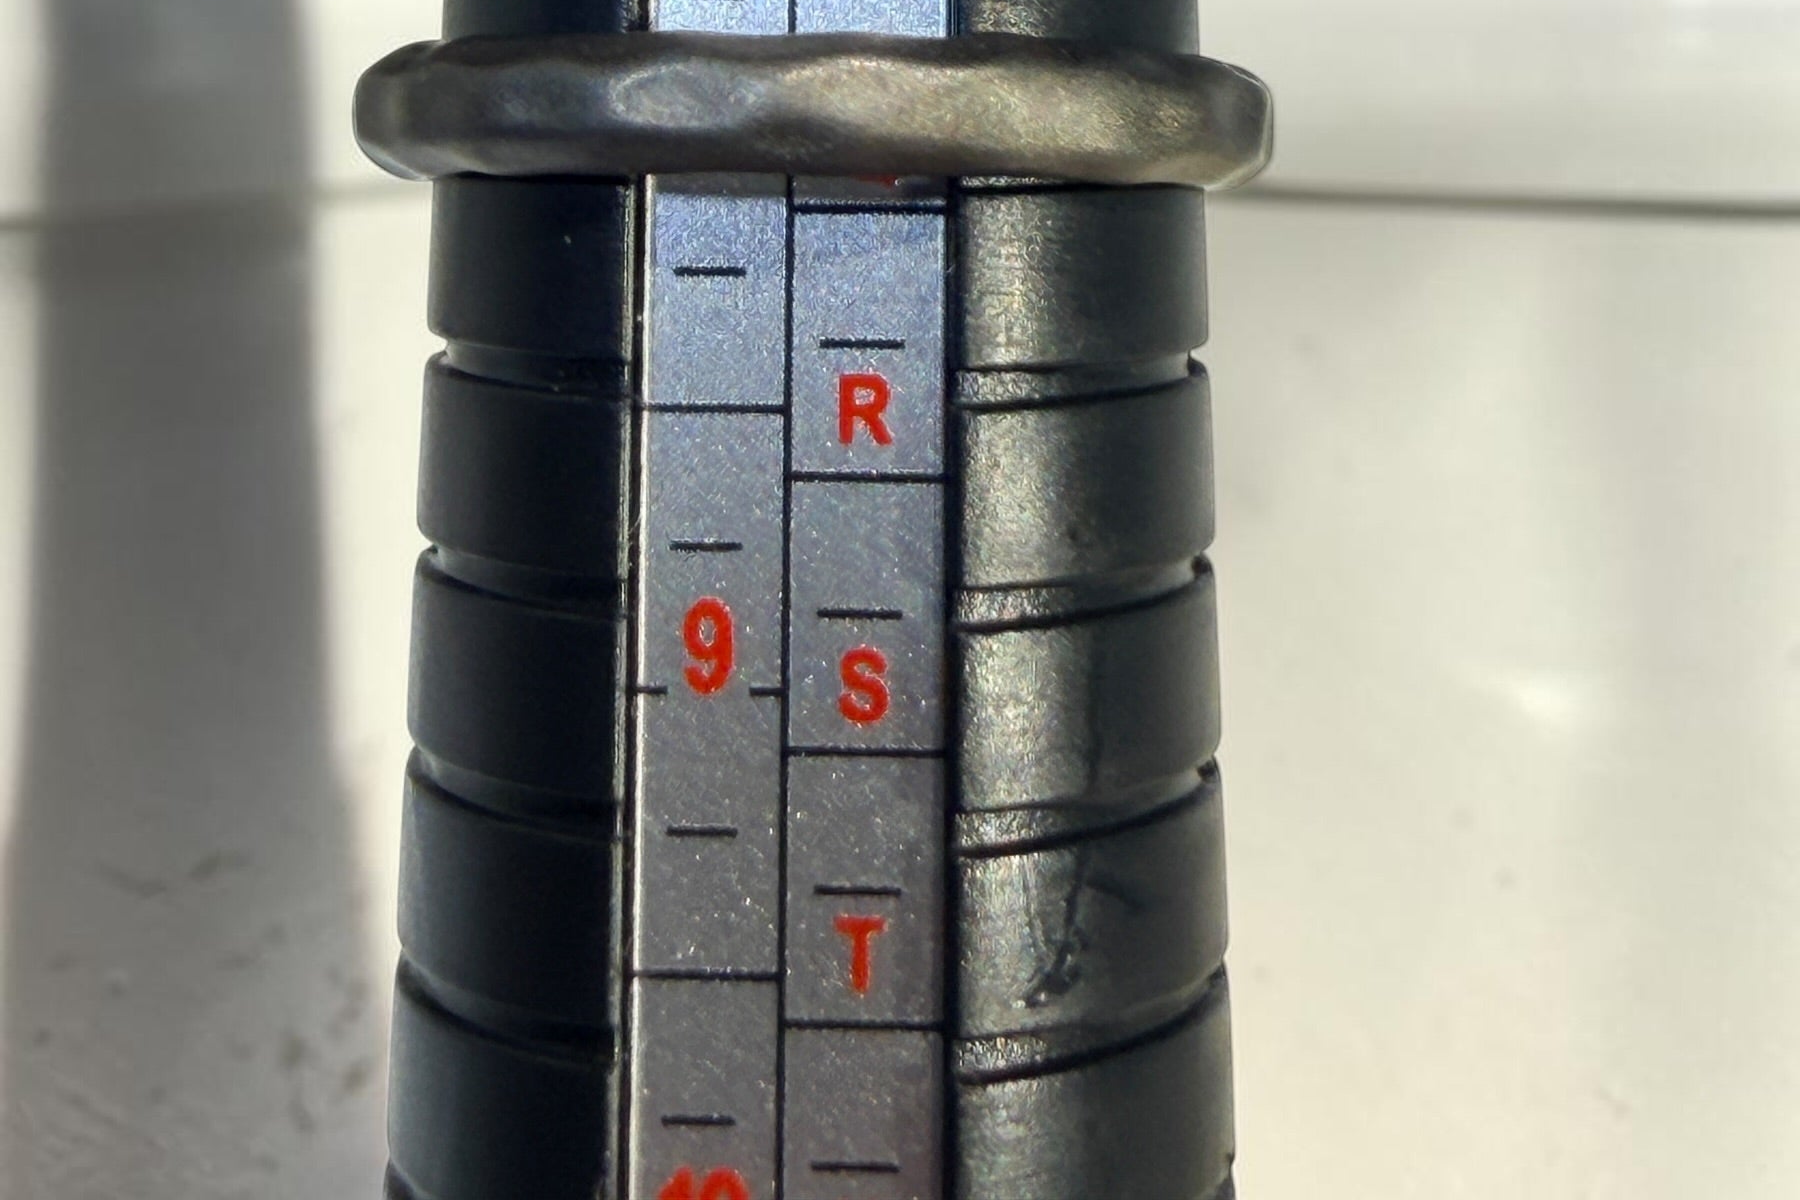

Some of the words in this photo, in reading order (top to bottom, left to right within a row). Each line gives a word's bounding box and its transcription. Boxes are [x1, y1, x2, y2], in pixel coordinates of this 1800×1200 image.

[837, 373, 893, 445] R
[682, 597, 735, 694] 9
[838, 647, 890, 725] S
[833, 915, 887, 994] T
